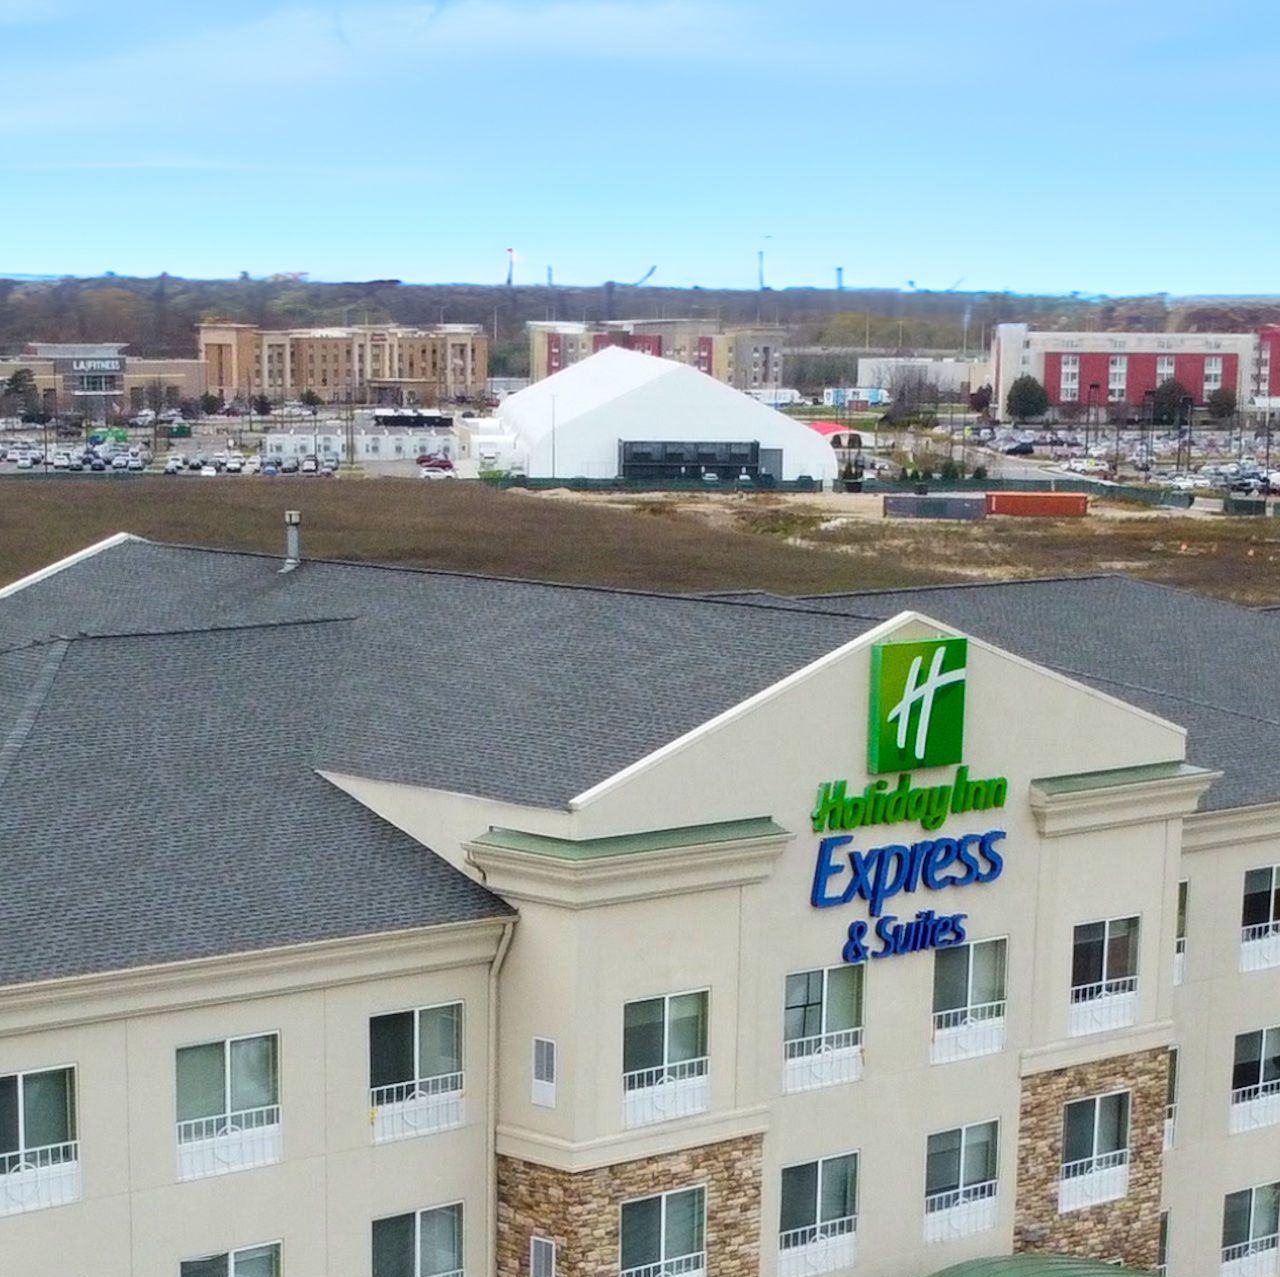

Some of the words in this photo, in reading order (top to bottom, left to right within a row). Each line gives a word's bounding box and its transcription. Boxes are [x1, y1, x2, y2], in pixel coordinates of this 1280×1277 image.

[73, 360, 86, 371] LA
[87, 360, 120, 370] FITNESS
[811, 773, 953, 833] Holiday
[951, 765, 1008, 814] Inn
[811, 830, 1007, 917] Express
[842, 920, 869, 963] &
[871, 910, 968, 959] Suites
